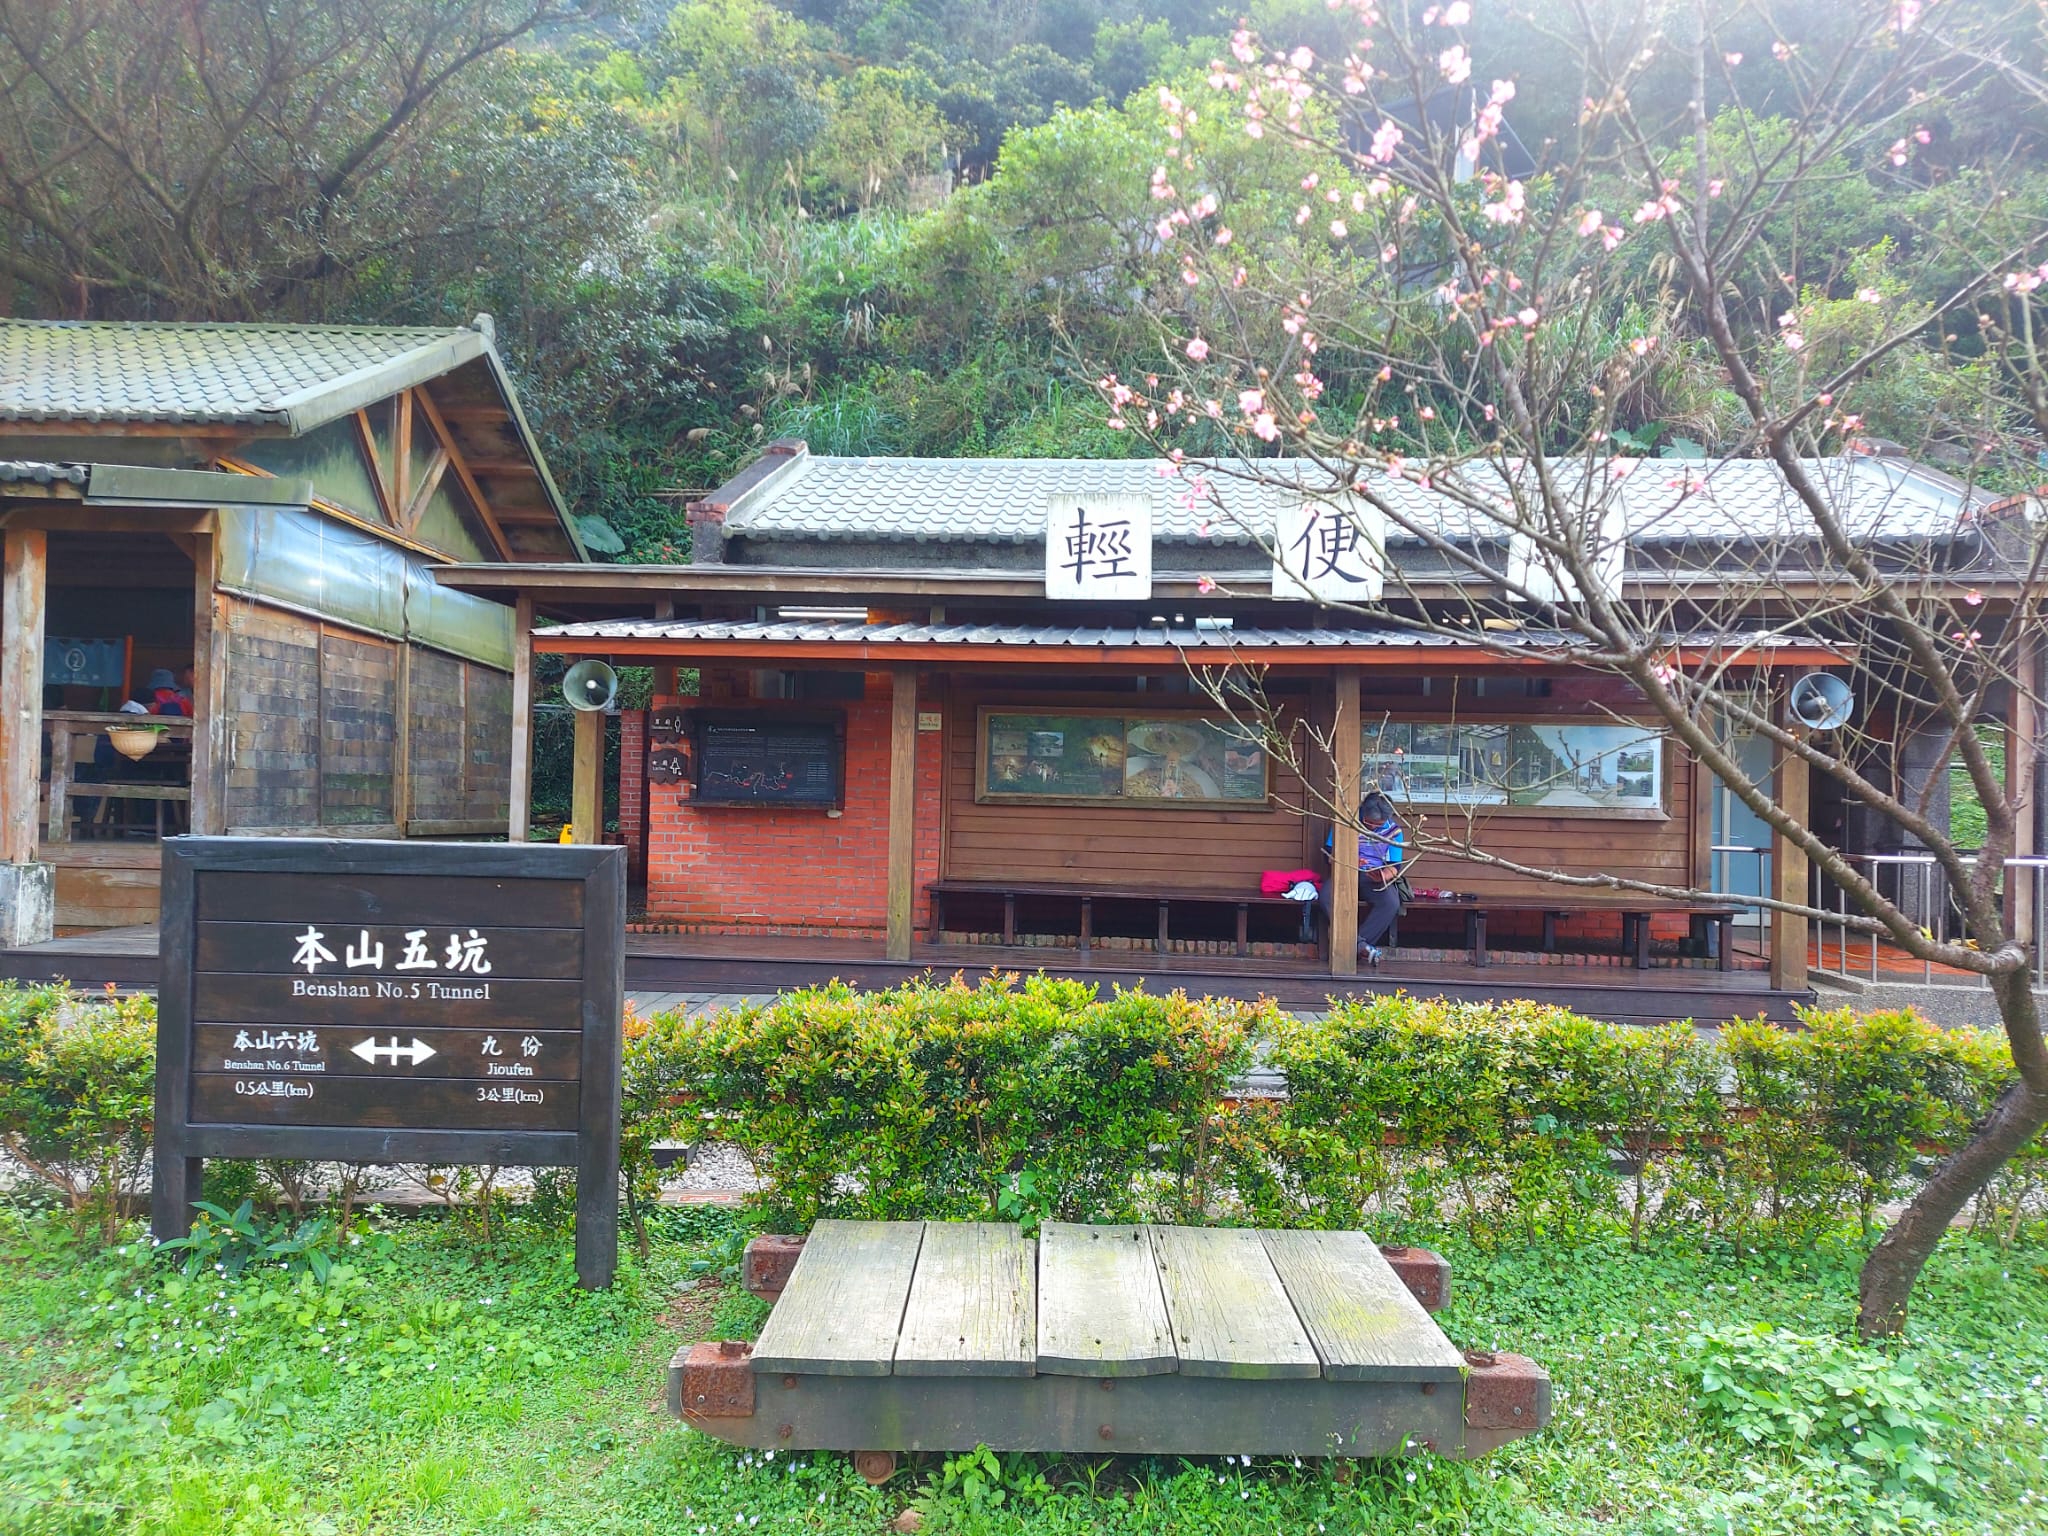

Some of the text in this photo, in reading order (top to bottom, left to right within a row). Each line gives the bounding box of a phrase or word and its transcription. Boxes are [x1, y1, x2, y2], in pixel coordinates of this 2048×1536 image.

[1060, 507, 1369, 585] 輕 便
[292, 925, 492, 974] 本山五坑
[292, 980, 491, 1000] Benshan No.5 Tunnel
[233, 1029, 320, 1052] 本山六坑
[224, 1059, 326, 1072] Benshan No.6 Tunnel
[487, 1062, 534, 1076] Jioufen
[235, 1081, 314, 1098] 0.5公里(km)
[476, 1087, 544, 1105] 3公里(km)
